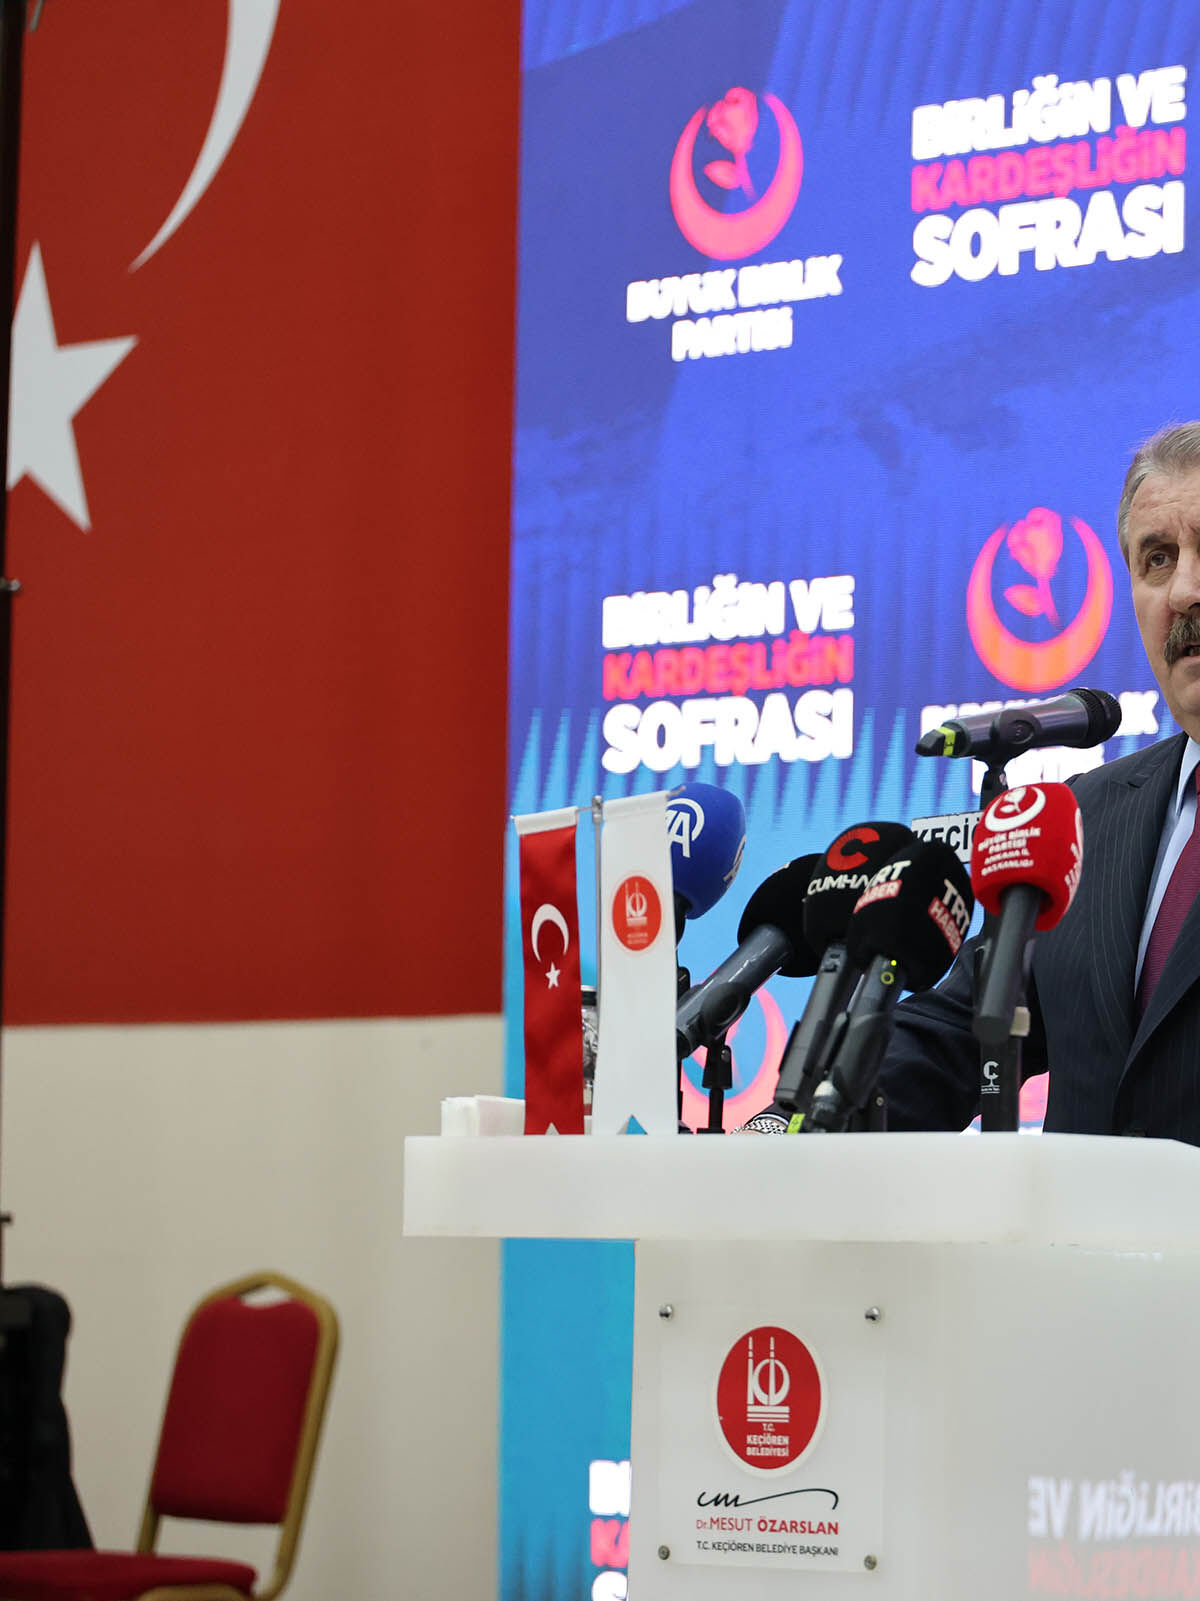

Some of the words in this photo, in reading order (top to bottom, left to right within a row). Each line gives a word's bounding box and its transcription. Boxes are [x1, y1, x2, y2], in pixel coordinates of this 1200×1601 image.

[912, 75, 1111, 160] BİRLİĞİN
[1117, 66, 1186, 127] VE
[911, 125, 1186, 213] KARDEŞLİĞİN
[911, 181, 1185, 287] SOFRASI
[789, 575, 855, 631] VE
[603, 629, 854, 701] KARDEŞLİĞİN
[602, 688, 854, 774] SOFRASI
[755, 1542, 798, 1554] BELEDİYE
[757, 1516, 839, 1535] ÖZARSLAN
